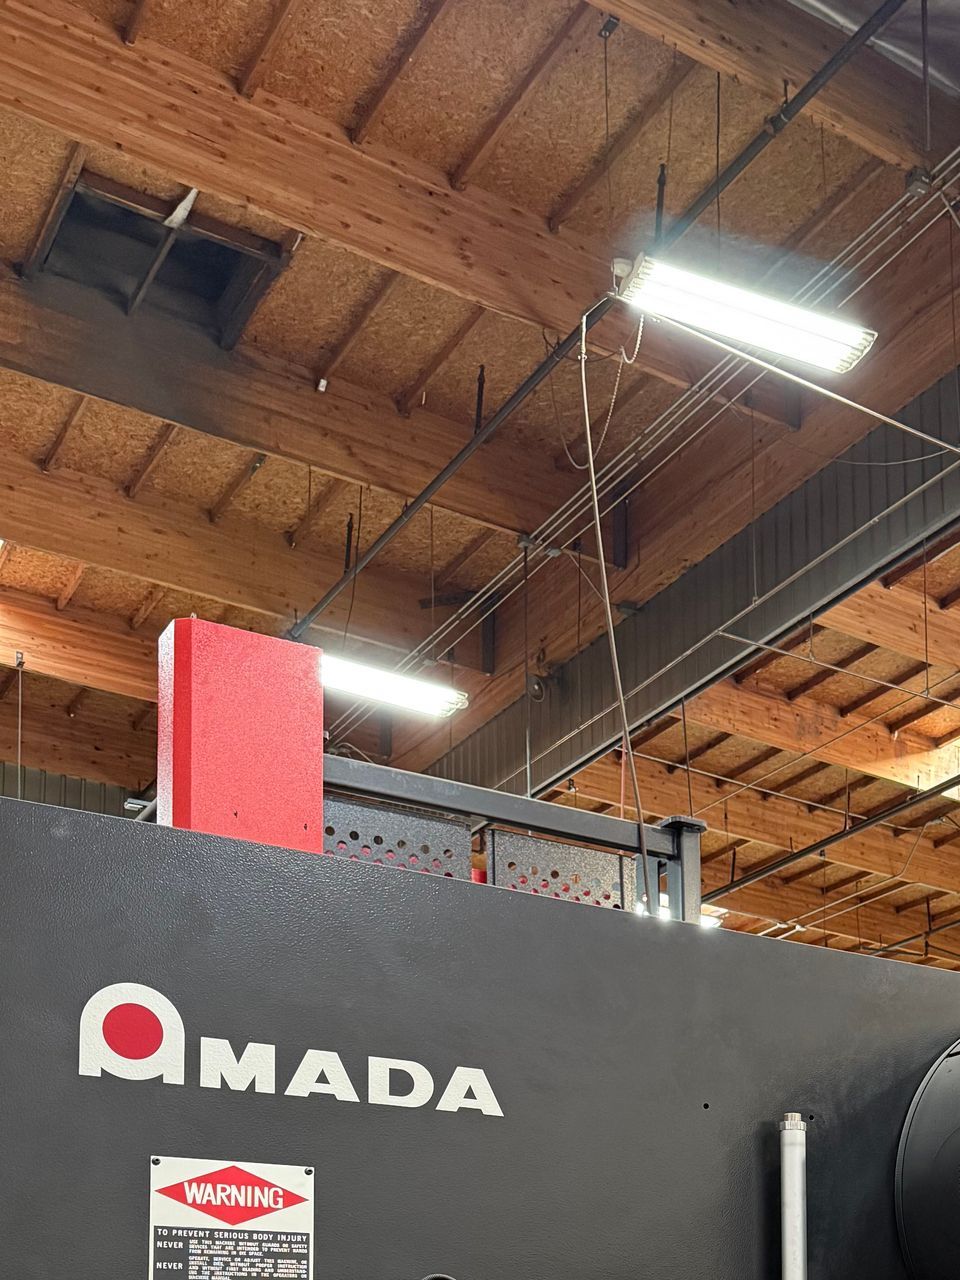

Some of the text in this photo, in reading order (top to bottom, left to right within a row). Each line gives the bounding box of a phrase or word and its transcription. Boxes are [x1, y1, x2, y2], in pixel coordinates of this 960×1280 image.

[78, 982, 505, 1117] AMADA
[184, 1182, 284, 1208] WARNING
[214, 1231, 248, 1239] SERIOUS
[278, 1234, 307, 1242] INJURY
[156, 1262, 183, 1270] NEVER
